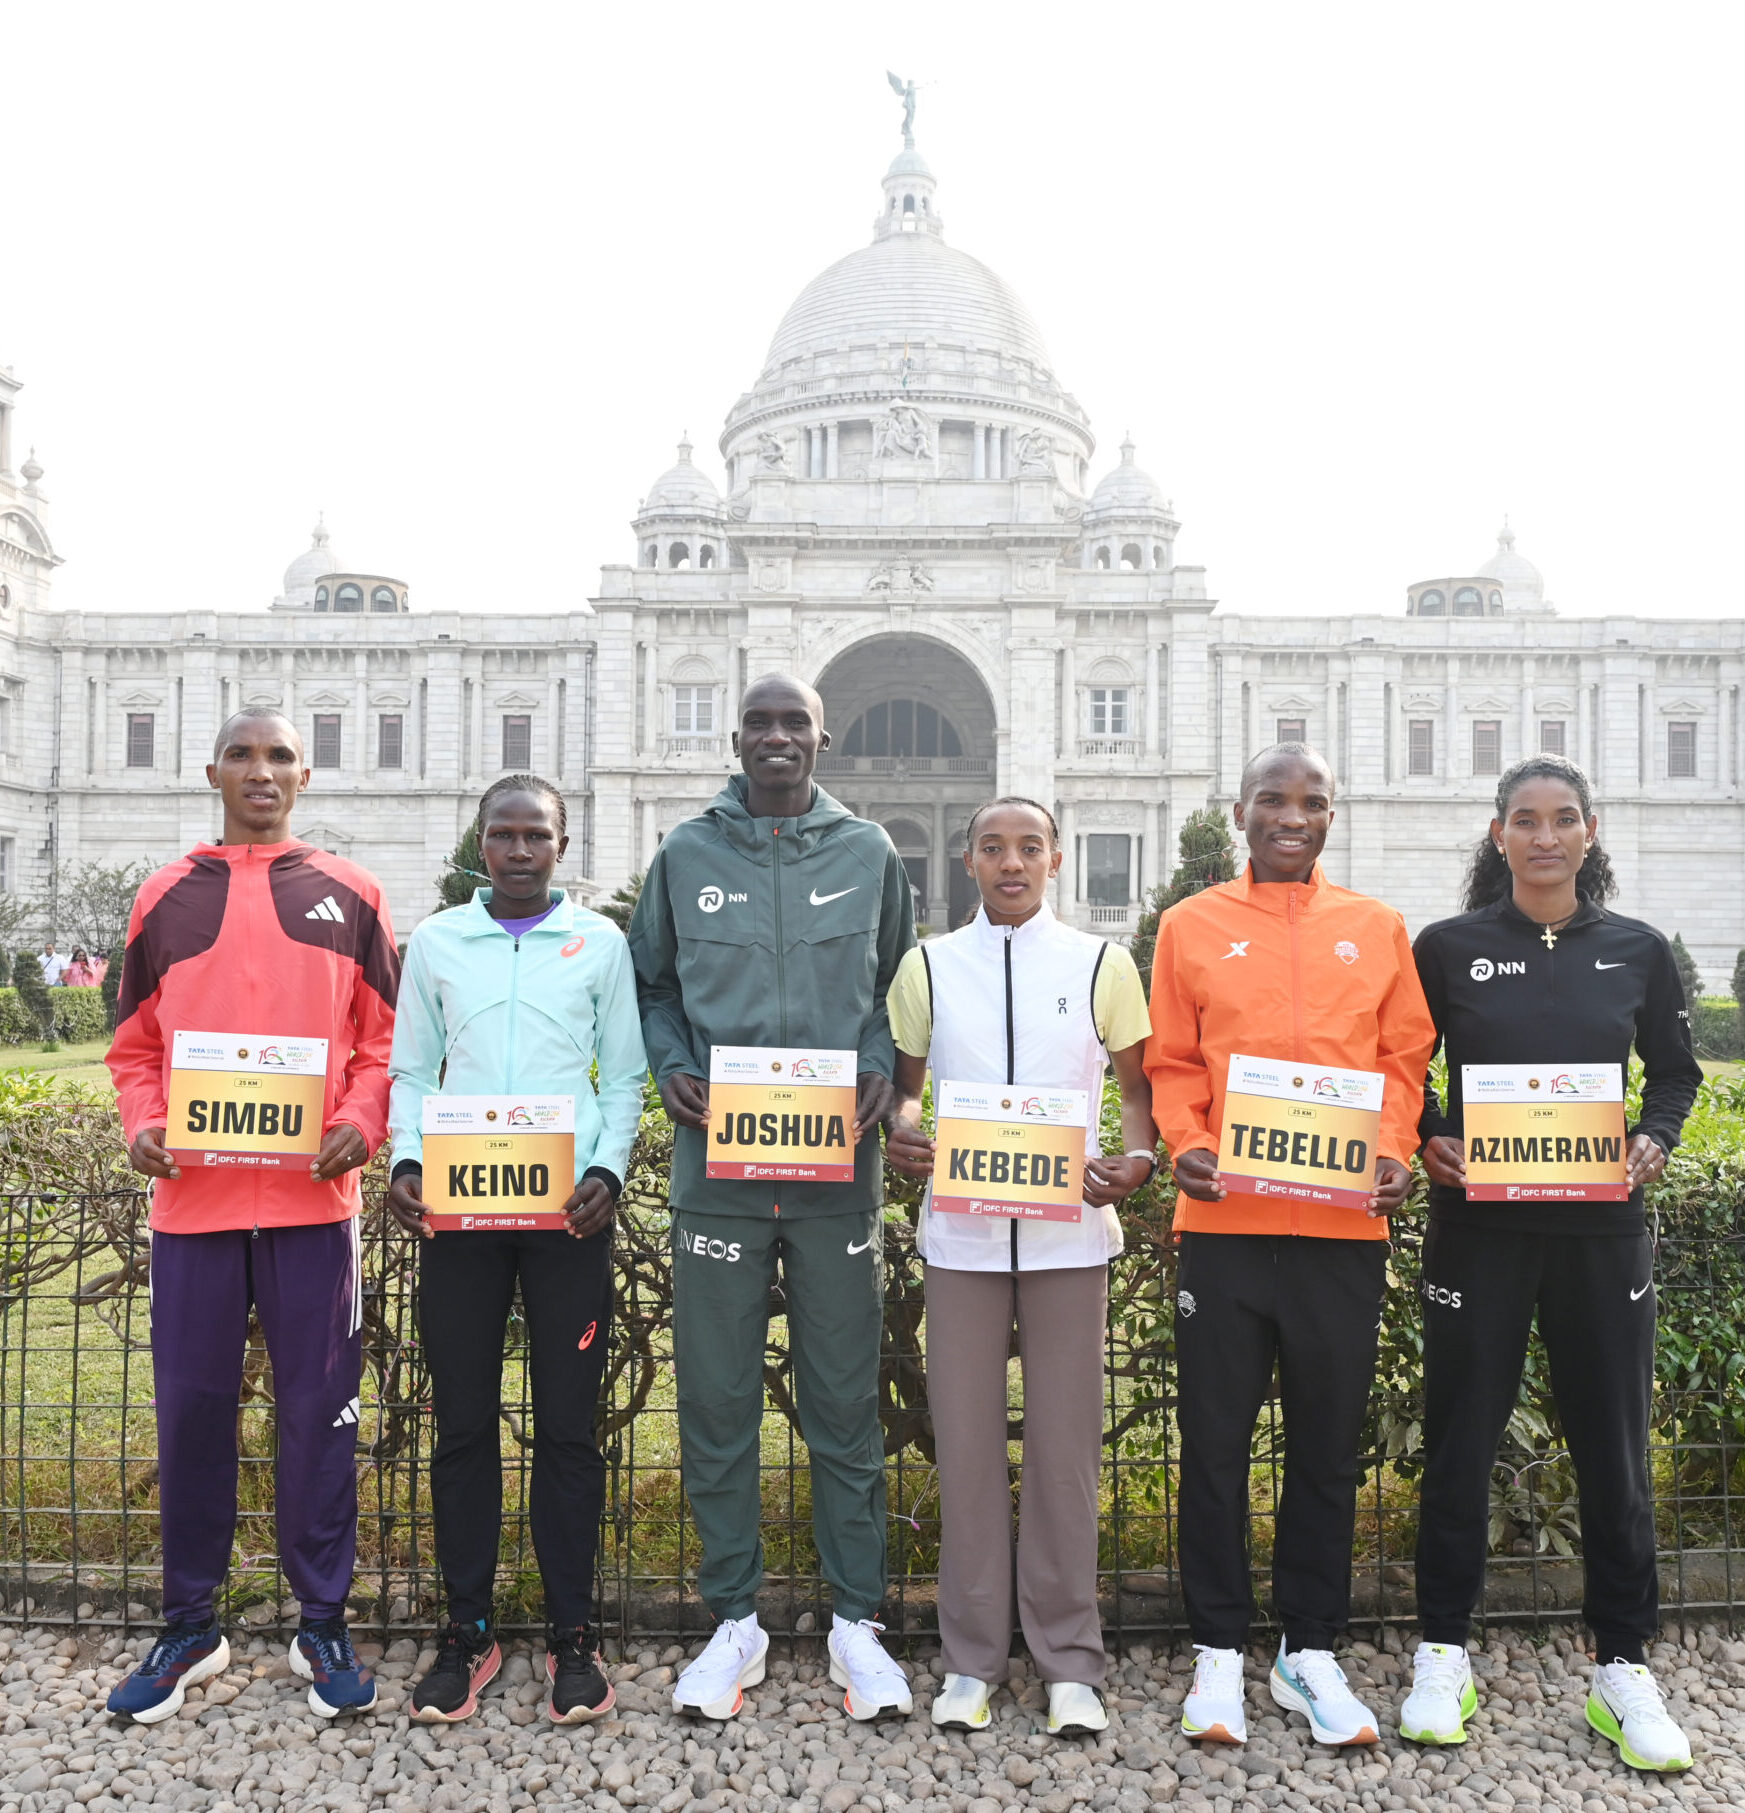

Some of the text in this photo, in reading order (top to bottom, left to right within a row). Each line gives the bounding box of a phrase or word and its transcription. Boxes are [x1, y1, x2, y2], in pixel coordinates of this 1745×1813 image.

[728, 892, 748, 902] NN
[1497, 961, 1526, 975] NN
[187, 1100, 303, 1137] SIMBU
[717, 1113, 846, 1147] JOSHUA
[1231, 1123, 1367, 1174] TEBELLO
[1470, 1137, 1621, 1162] AZIMERAW
[449, 1164, 548, 1197] KEINO
[949, 1148, 1069, 1188] KEBEDE
[1269, 1185, 1287, 1194] IDFC
[1289, 1187, 1311, 1197] FIRST
[1313, 1191, 1332, 1200] Bank
[1002, 1206, 1023, 1214] FIRST
[1421, 1279, 1462, 1309] EOS
